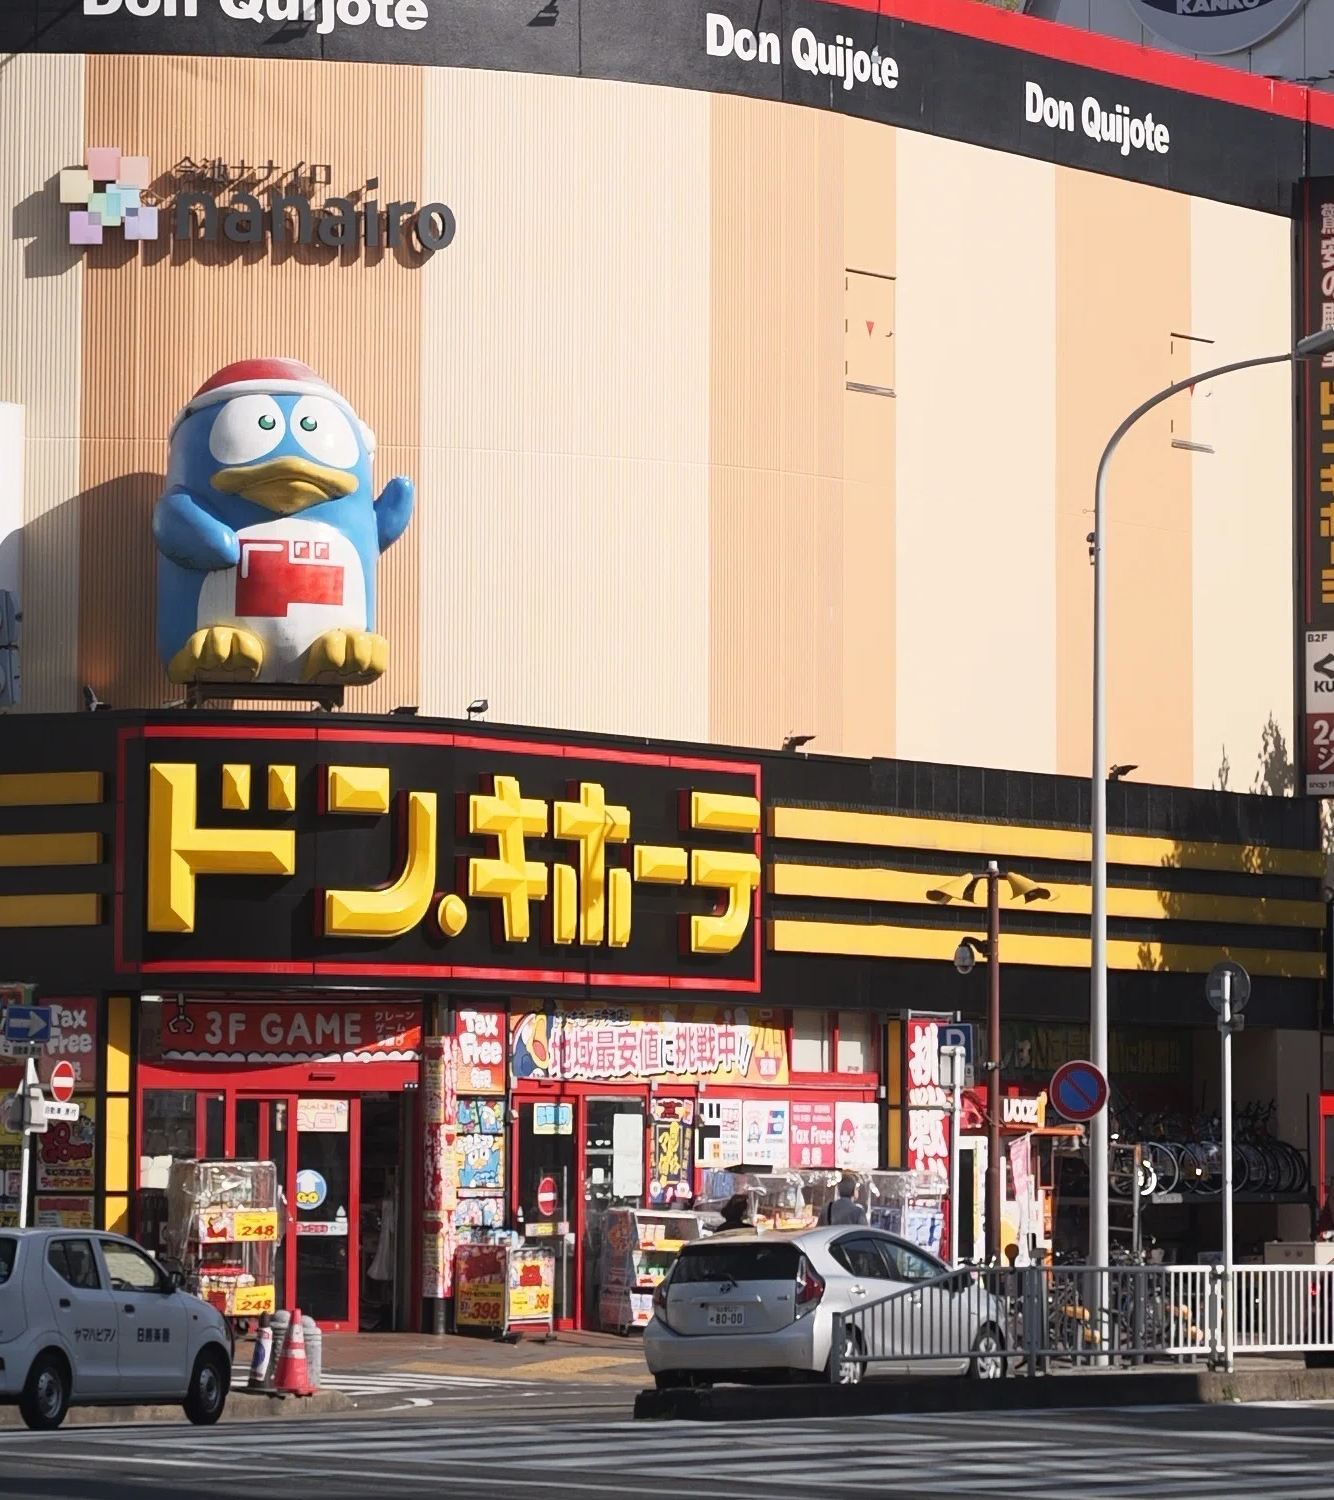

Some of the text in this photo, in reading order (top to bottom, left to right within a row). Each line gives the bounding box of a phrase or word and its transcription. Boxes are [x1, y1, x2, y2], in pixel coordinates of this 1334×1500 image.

[706, 13, 900, 92] Don Quijote
[1024, 81, 1171, 157] Don Quijote
[175, 177, 456, 250] nanairo
[1307, 633, 1328, 643] B2F
[49, 1004, 87, 1029] Tax
[204, 1011, 246, 1045] 3F
[260, 1012, 362, 1046] GAME
[374, 1011, 415, 1021] クレーン
[459, 1011, 499, 1037] Tax
[46, 1027, 92, 1055] Free
[459, 1033, 502, 1065] Free
[791, 1126, 833, 1144] Tax Free
[242, 1225, 274, 1235] 248
[241, 1300, 271, 1311] 248
[471, 1302, 500, 1318] 398
